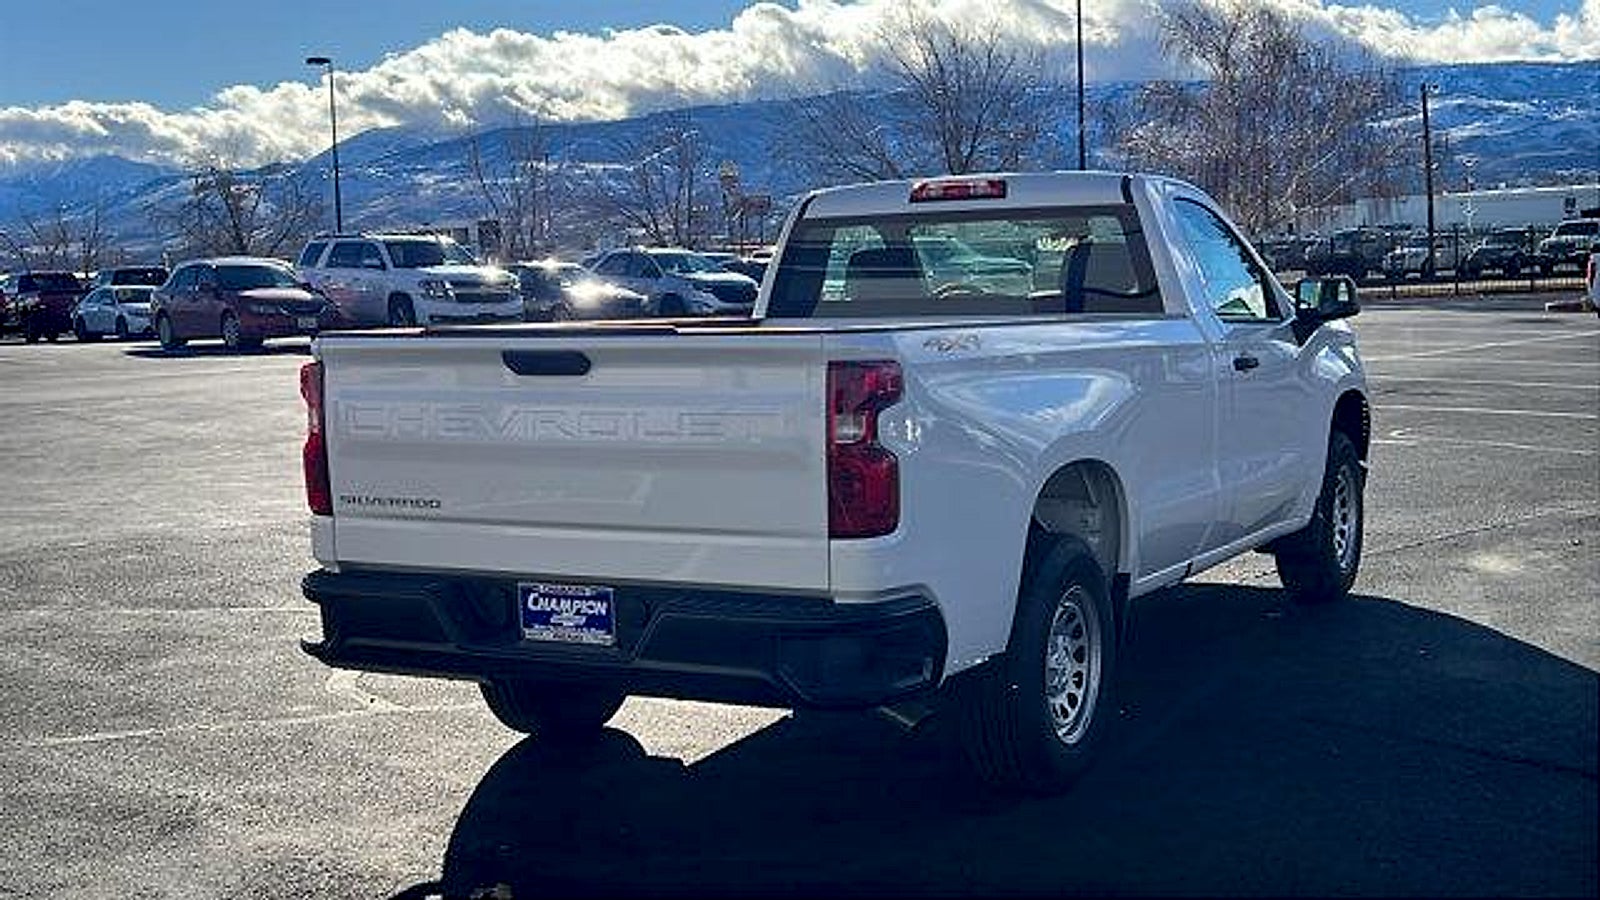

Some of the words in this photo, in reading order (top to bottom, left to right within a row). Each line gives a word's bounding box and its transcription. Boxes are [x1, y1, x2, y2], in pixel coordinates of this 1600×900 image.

[342, 402, 786, 443] CHEVROLET
[339, 494, 441, 509] SILVERADO
[527, 592, 608, 616] CHAMPION
